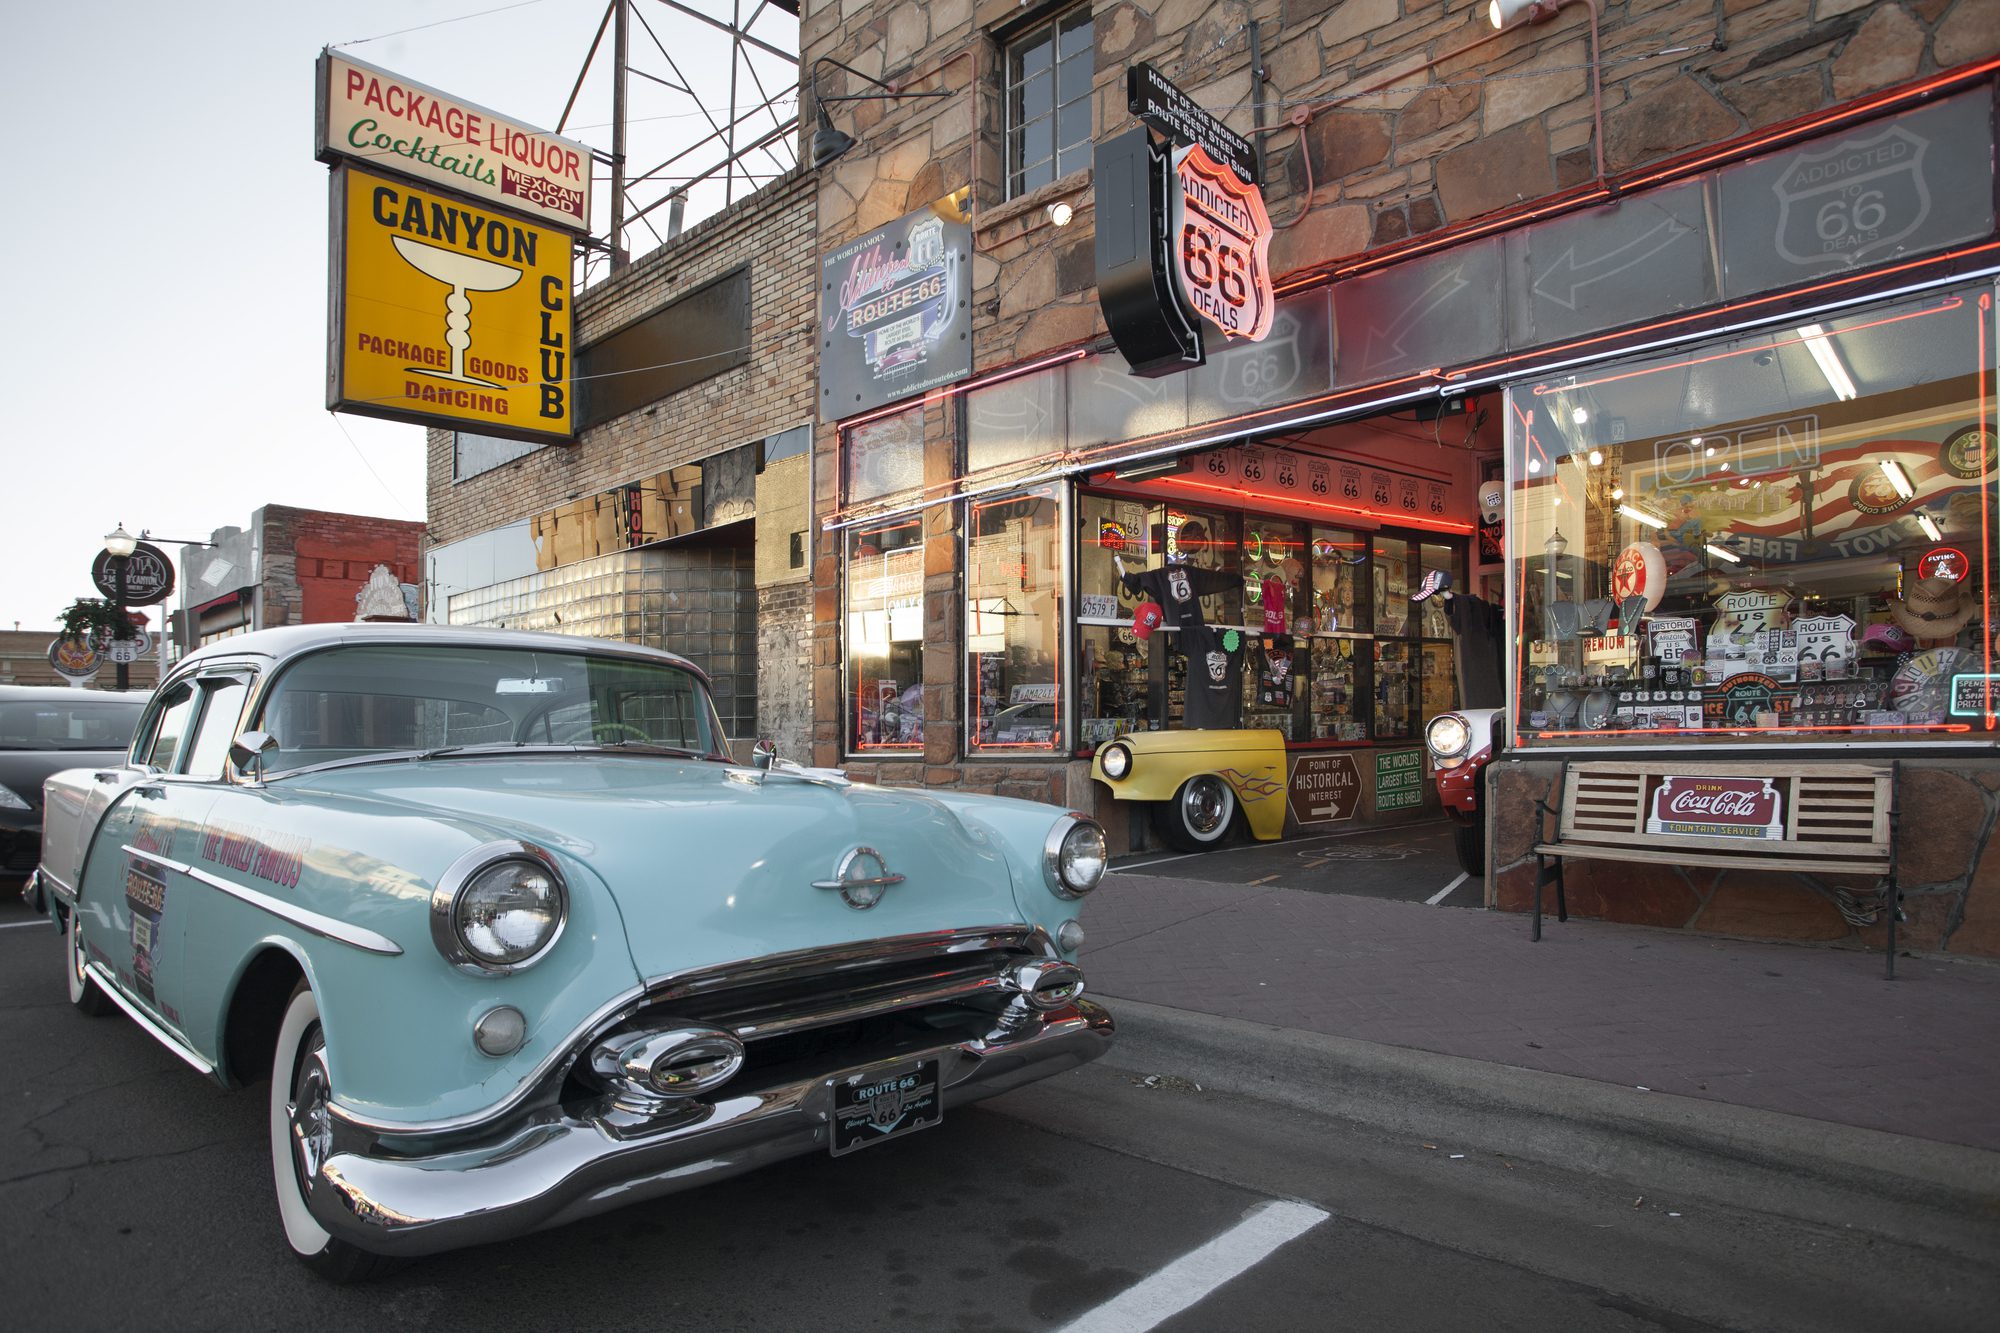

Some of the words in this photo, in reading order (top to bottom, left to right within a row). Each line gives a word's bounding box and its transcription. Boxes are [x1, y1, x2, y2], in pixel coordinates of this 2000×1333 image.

[1148, 69, 1178, 101] HOME
[1179, 95, 1190, 110] OF
[1192, 105, 1210, 127] THE
[1211, 119, 1249, 155] WORLD'S
[347, 68, 481, 146] PACKAGE
[490, 122, 580, 182] LIQUOR
[1167, 97, 1206, 136] LARGEST
[1208, 130, 1235, 157] STEEL
[1147, 98, 1180, 131] ROUTE
[1182, 124, 1196, 141] 66
[1198, 136, 1229, 164] SHIELD
[1231, 158, 1252, 182] SIGN
[347, 118, 496, 187] Cocktails
[1793, 141, 1907, 187] ADDICTED
[506, 168, 581, 205] MEXICAN
[1839, 184, 1863, 199] TO
[515, 185, 575, 214] FOOD
[1180, 171, 1248, 232] ADDICTED
[1816, 190, 1887, 240] 66
[372, 186, 538, 267] CANYON
[1822, 228, 1879, 253] DEALS
[824, 258, 836, 268] THE
[837, 245, 859, 261] WORLD
[859, 232, 886, 251] FAMOUS
[1183, 222, 1248, 308] 66
[852, 287, 913, 328] ROUTE
[918, 276, 941, 302] 66
[1193, 287, 1238, 330] DEALS
[539, 275, 565, 419] CLUB
[358, 332, 447, 368] PACKAGE
[469, 357, 529, 384] GOODS
[1241, 355, 1278, 387] 66
[405, 380, 509, 416] DANCING
[1662, 419, 1811, 482] OPEN
[1208, 459, 1226, 474] 66
[1245, 464, 1261, 479] 66
[1279, 472, 1295, 486] 66
[1312, 480, 1327, 493] 66
[1344, 484, 1358, 497] 66
[1374, 491, 1388, 504] 66
[1403, 496, 1416, 509] 66
[1430, 500, 1443, 513] 66
[630, 491, 641, 547] HOT
[1127, 521, 1139, 535] 66
[1927, 553, 1956, 562] FLYING
[1082, 601, 1107, 616] 67579
[1110, 604, 1116, 616] P
[1726, 594, 1777, 609] ROUTE
[1737, 612, 1764, 621] US
[1651, 620, 1692, 632] HISTORIC
[1800, 621, 1841, 632] ROUTE
[1583, 636, 1625, 653] PREMIUM
[1658, 633, 1687, 641] ARIZONA
[1807, 635, 1832, 643] US
[116, 651, 131, 661] 66
[1764, 656, 1776, 664] 66
[1781, 655, 1794, 663] 66
[1919, 655, 1936, 670] 11
[1938, 650, 1955, 665] 12
[1903, 666, 1921, 683] 10
[1721, 675, 1775, 693] AUTHORIZED
[1894, 683, 1919, 693] 9
[1958, 680, 1985, 688] SPEND
[1704, 703, 1724, 714] ICE
[1896, 694, 1919, 709] 8
[1957, 700, 1984, 708] PRIZE
[1309, 760, 1331, 771] POINT
[1332, 759, 1341, 769] OF
[1379, 756, 1391, 769] THE
[1392, 753, 1419, 766] WORLD'S
[1296, 771, 1354, 790] HISTORICAL
[1378, 774, 1402, 791] LARGEST
[1403, 770, 1420, 784] STEEL
[1308, 790, 1342, 802] INTEREST
[1378, 793, 1396, 808] ROUTE
[1396, 792, 1404, 804] 66
[1403, 790, 1421, 804] SHIELD
[1670, 789, 1760, 817] Coca-Cola
[1668, 823, 1717, 833] FOUNTAIN
[1721, 825, 1760, 836] SERVICE
[202, 826, 223, 862] THE
[219, 827, 260, 872] WORLD
[251, 831, 312, 889] FAMOUS
[127, 872, 152, 905] ROUTE
[858, 1081, 897, 1100] ROUTE
[899, 1077, 915, 1089] 66
[878, 1108, 896, 1123] 66
